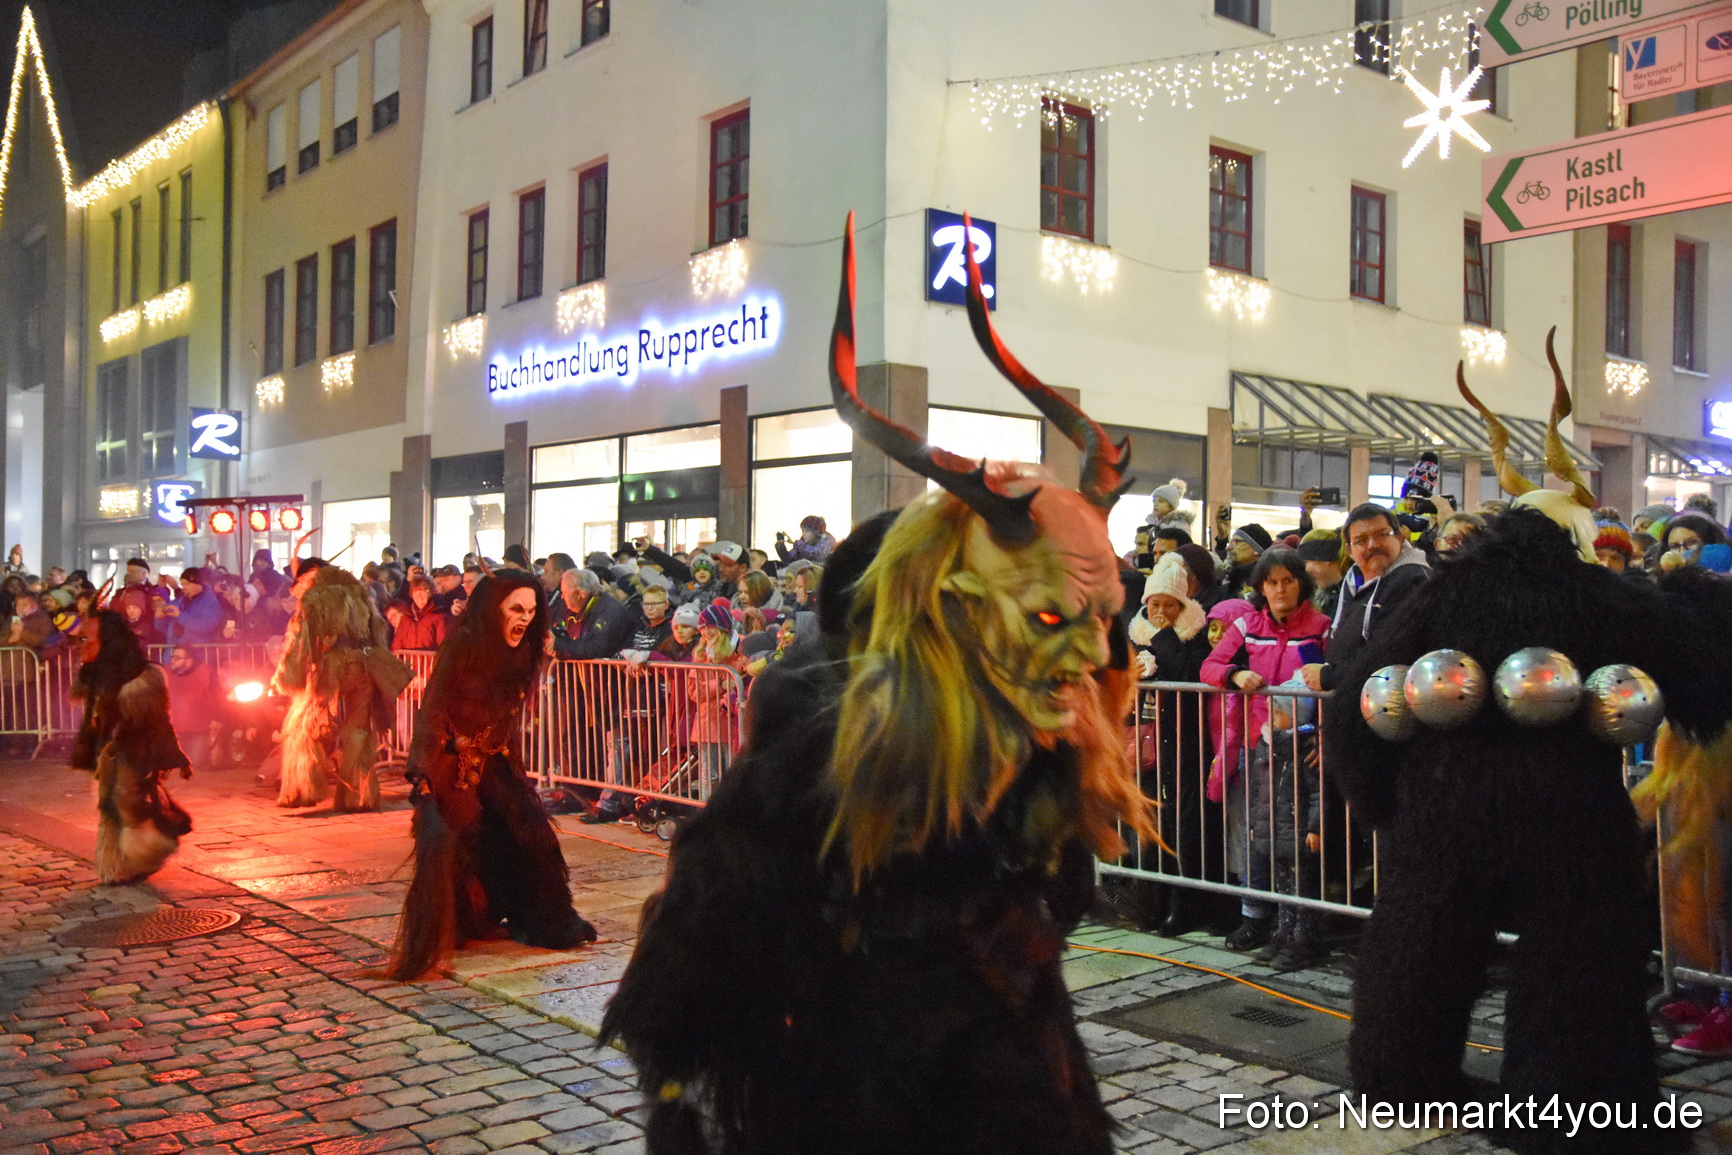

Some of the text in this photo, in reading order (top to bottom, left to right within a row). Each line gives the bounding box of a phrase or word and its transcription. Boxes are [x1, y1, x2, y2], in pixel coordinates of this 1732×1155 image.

[1566, 0, 1642, 30] Pölling
[1647, 76, 1673, 88] Radler
[1566, 149, 1622, 181] Kastl
[1566, 177, 1645, 211] Pilsach
[488, 304, 769, 393] Buchhandlung Rupprecht
